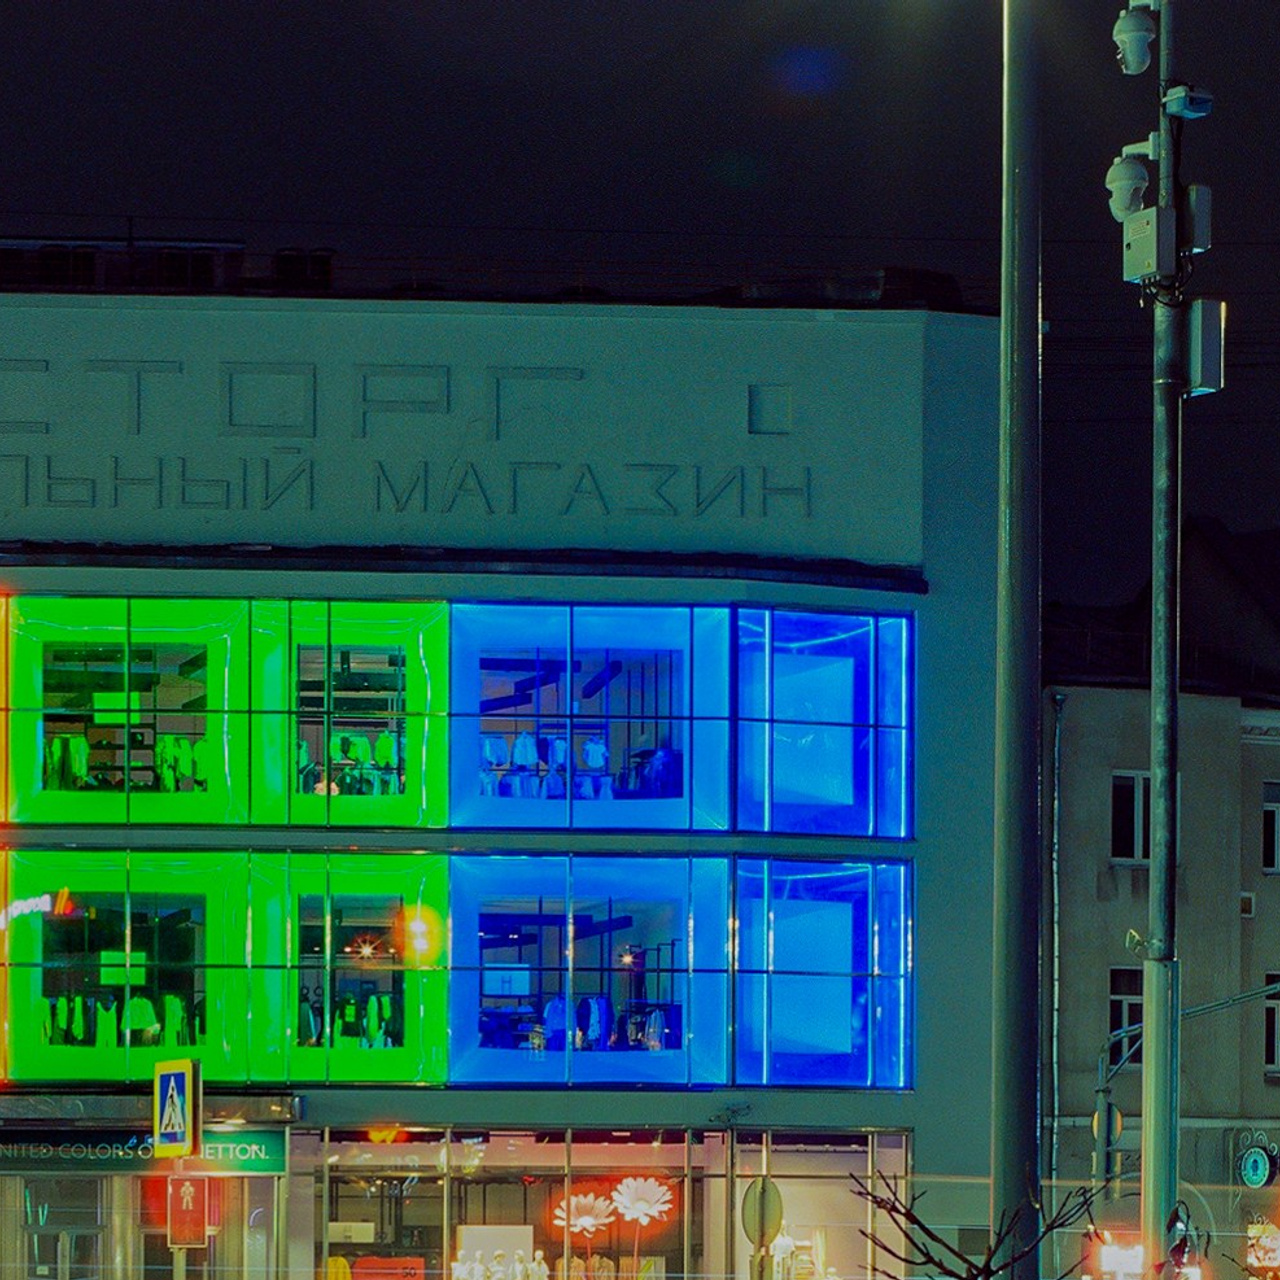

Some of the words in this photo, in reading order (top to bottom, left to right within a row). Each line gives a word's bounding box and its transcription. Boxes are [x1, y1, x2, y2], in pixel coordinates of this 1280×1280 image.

[372, 458, 813, 517] МАГАЗИН
[58, 1143, 132, 1160] COLORS
[137, 1144, 154, 1160] O
